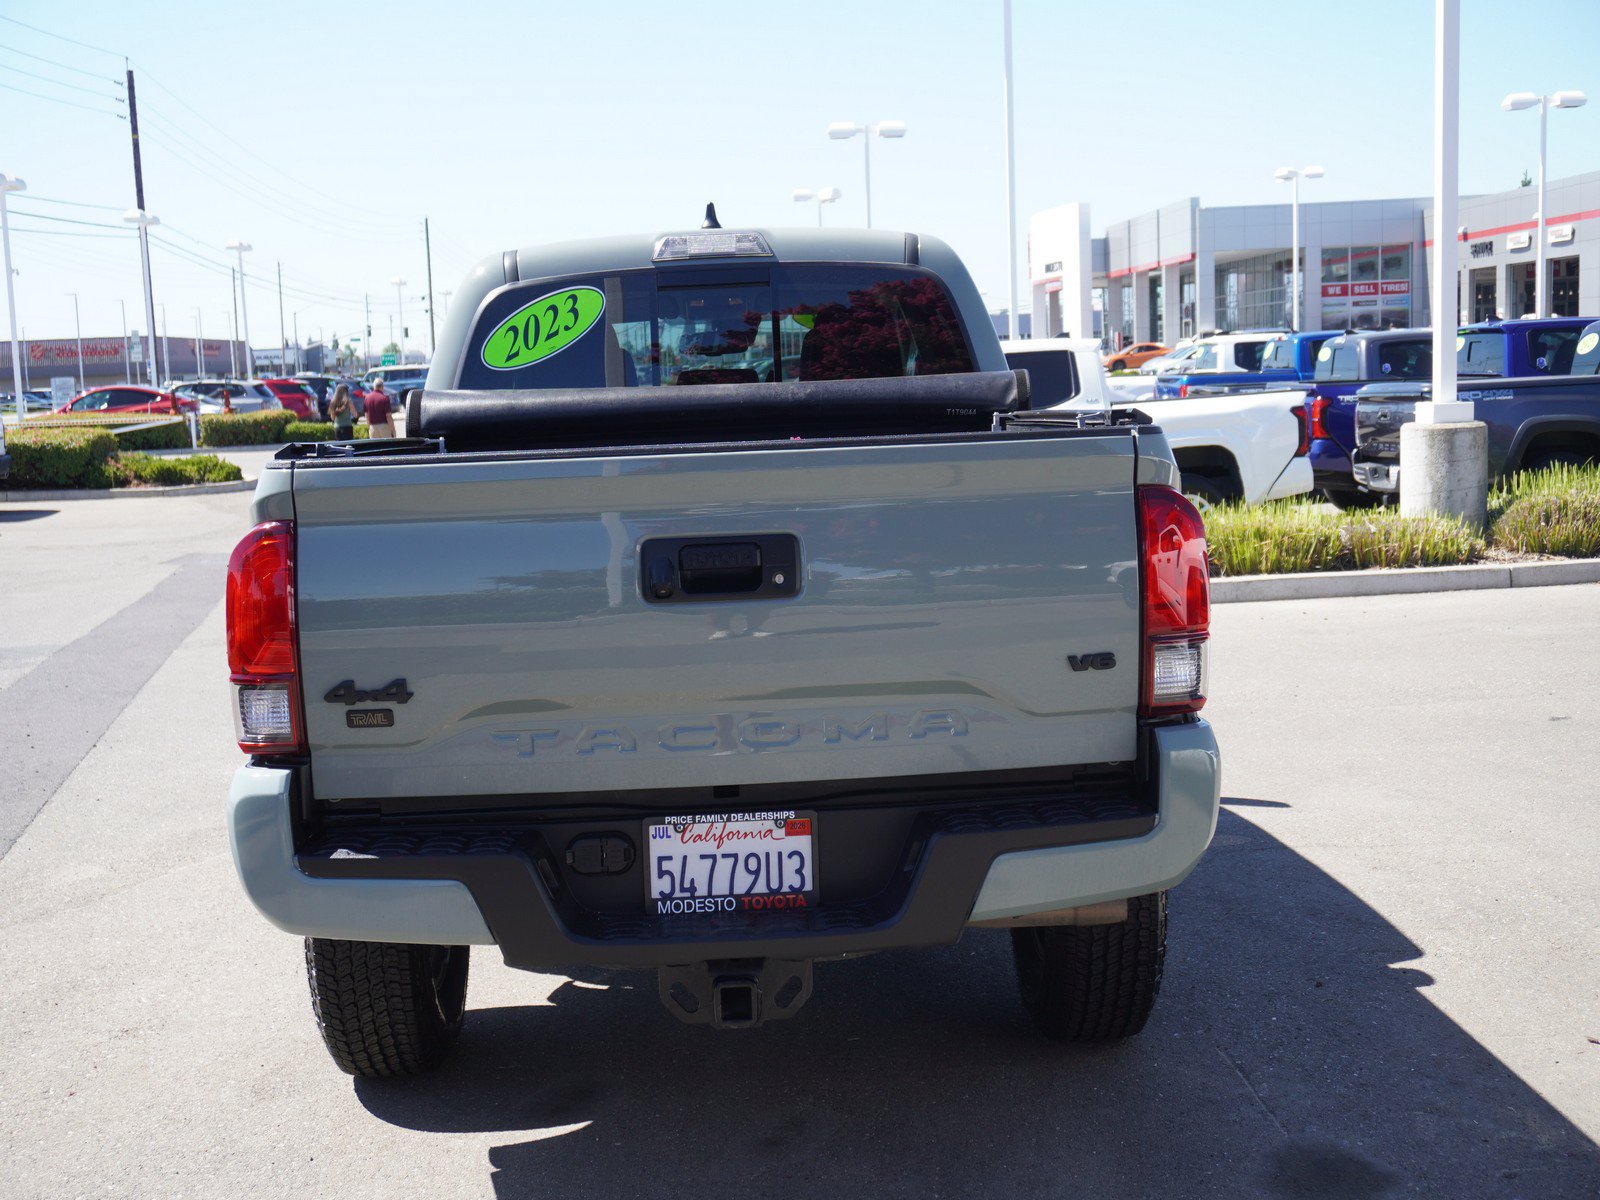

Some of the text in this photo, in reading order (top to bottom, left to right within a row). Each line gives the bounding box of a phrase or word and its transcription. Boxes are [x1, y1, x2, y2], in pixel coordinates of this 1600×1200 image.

[1327, 283, 1409, 295] WE SELL TIRES!
[503, 293, 580, 364] 2023
[1066, 651, 1117, 672] V6
[350, 712, 389, 725] TRAIL
[489, 708, 970, 758] TACOMA
[665, 810, 796, 825] PRICE FAMILY DEALERSHIPS
[651, 825, 672, 840] JUL
[680, 821, 786, 850] California
[656, 850, 806, 899] 54779U3
[657, 894, 808, 914] MODESTO TOYOTA
